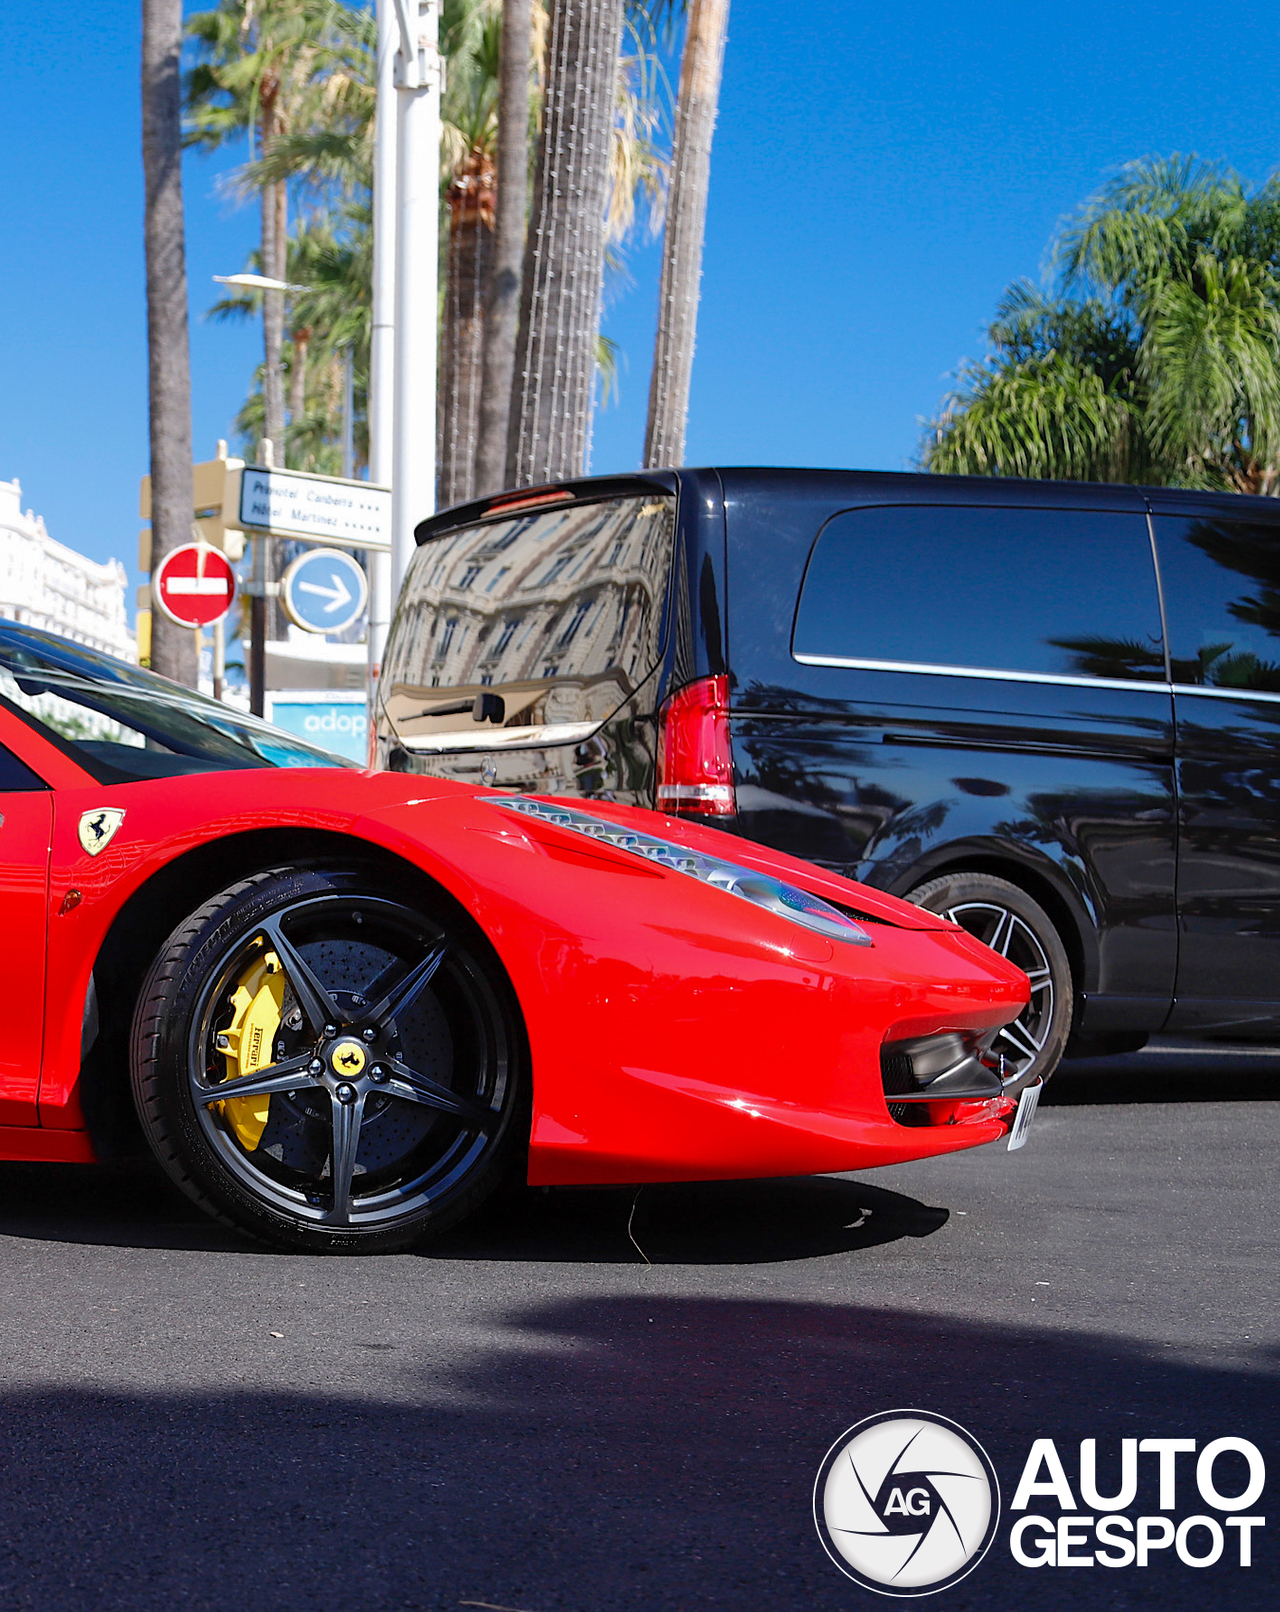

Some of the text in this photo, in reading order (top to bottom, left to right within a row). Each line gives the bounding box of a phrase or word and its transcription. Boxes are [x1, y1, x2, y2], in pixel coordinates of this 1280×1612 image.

[307, 490, 353, 508] Canberra
[291, 508, 338, 527] Martinez
[304, 707, 367, 737] adop
[250, 1026, 263, 1067] Ferrari
